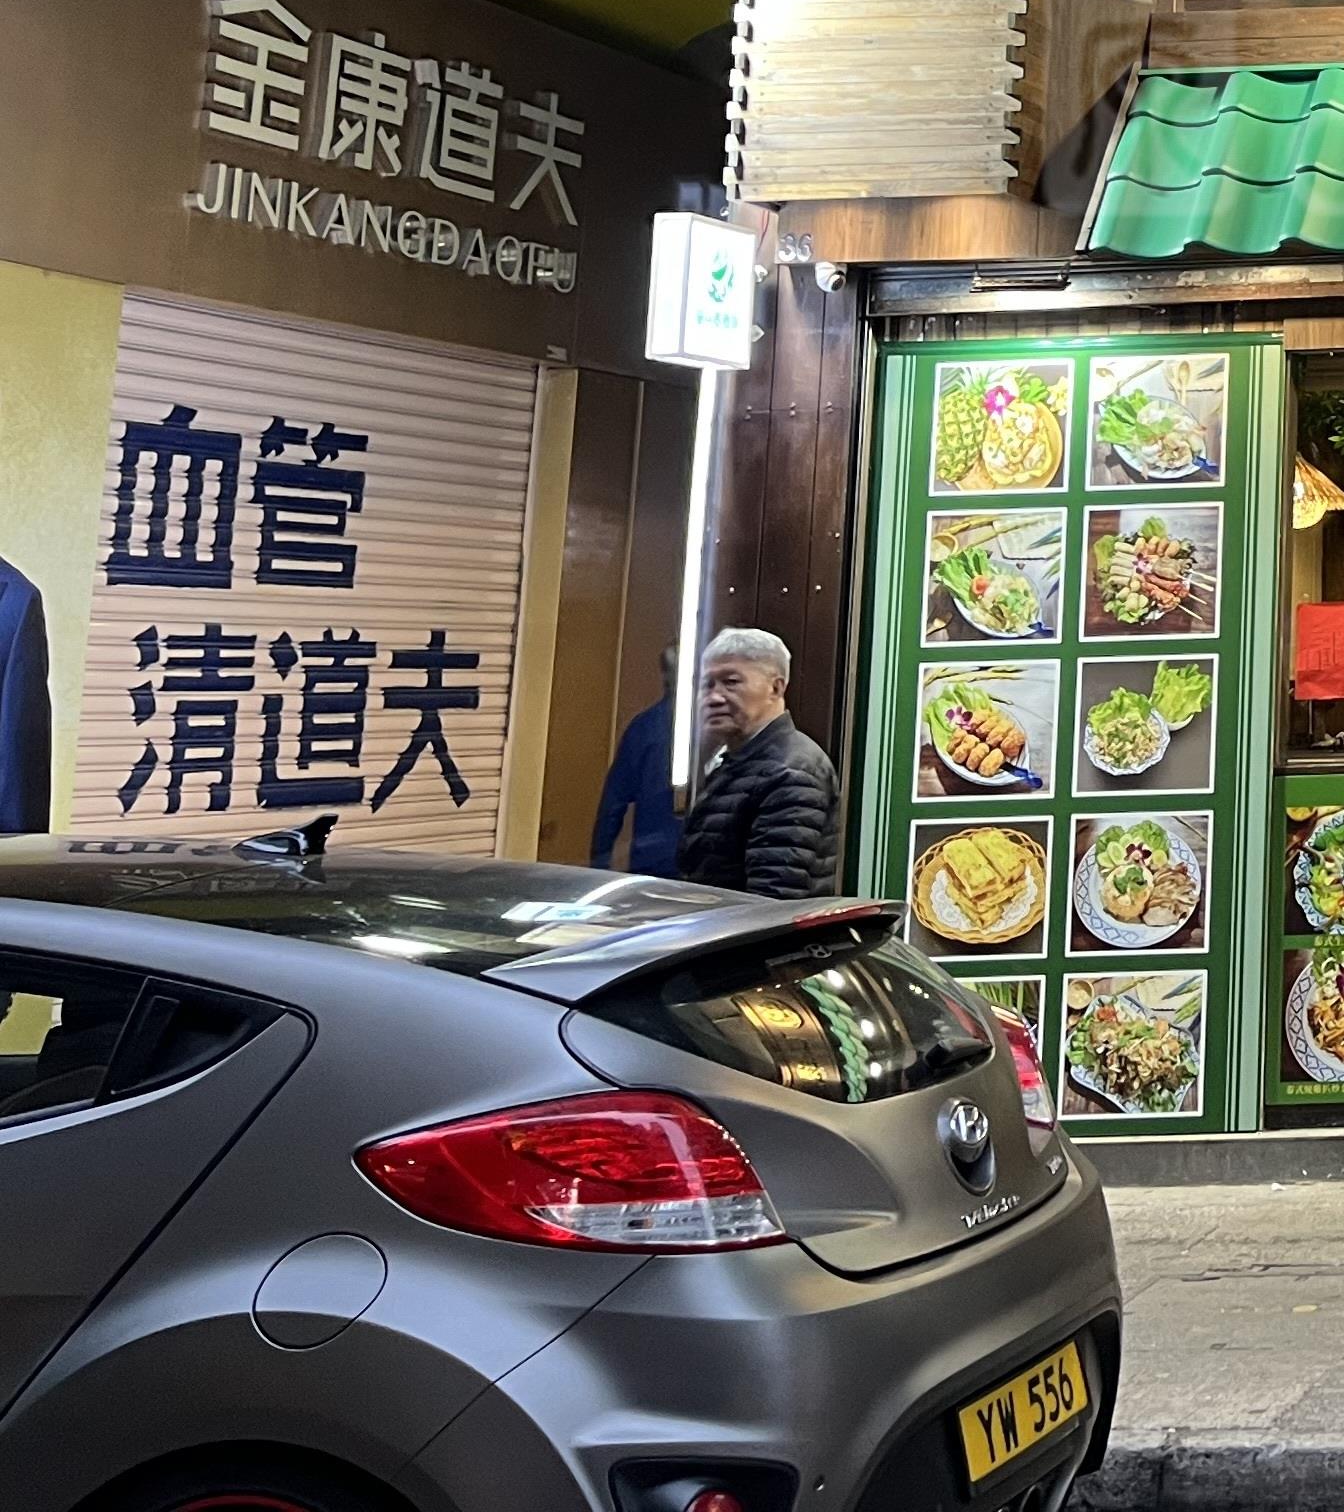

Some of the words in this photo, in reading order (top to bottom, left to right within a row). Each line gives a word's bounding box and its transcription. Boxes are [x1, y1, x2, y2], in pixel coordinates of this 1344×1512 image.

[105, 404, 369, 589] 血管
[117, 622, 480, 814] 清道夫
[976, 1391, 1019, 1464] YW
[1027, 1357, 1074, 1433] 556
